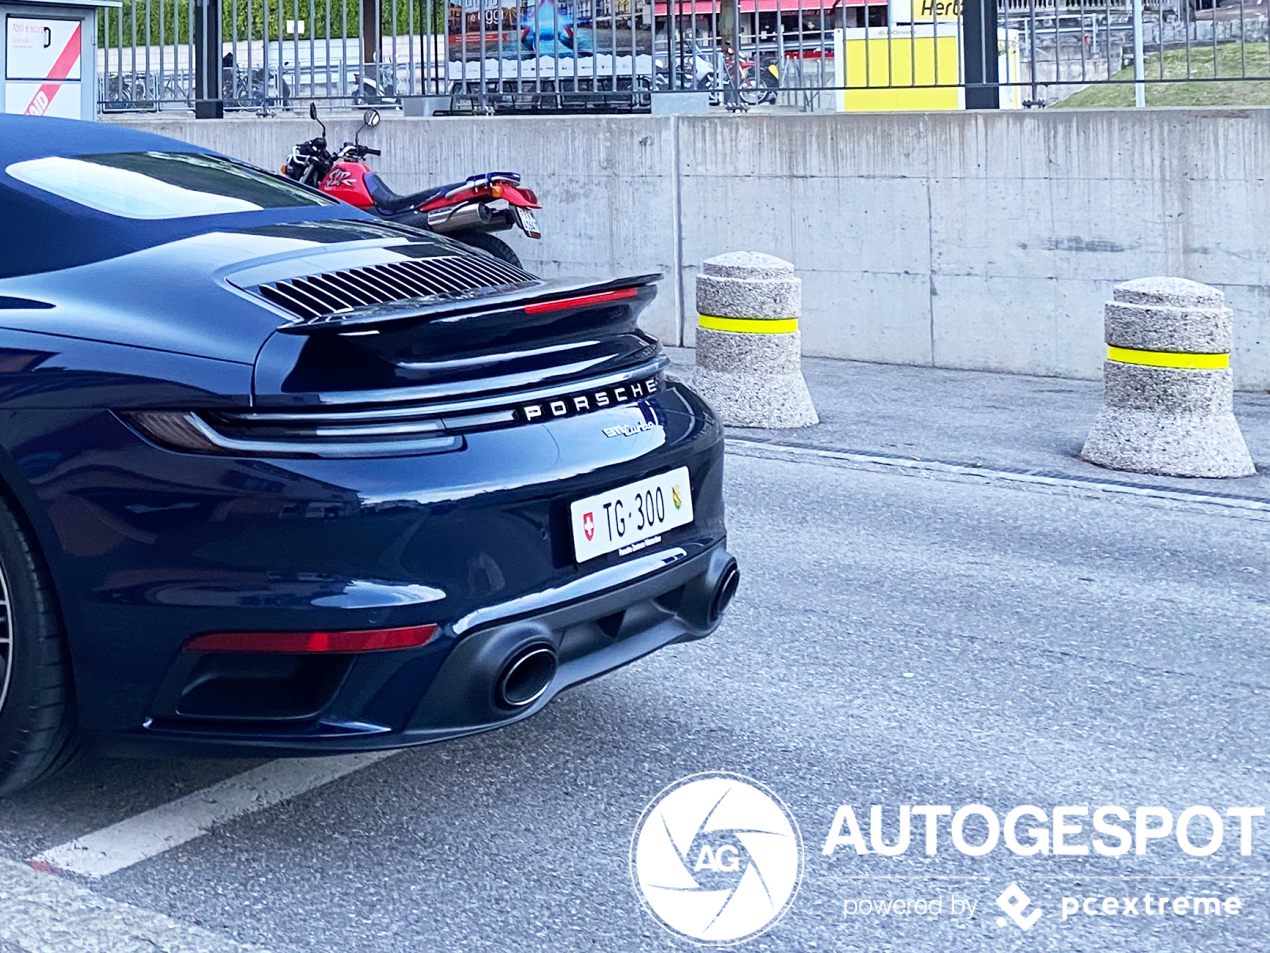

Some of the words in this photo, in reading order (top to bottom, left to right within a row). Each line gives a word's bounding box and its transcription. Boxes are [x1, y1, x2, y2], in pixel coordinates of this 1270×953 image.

[921, 0, 964, 16] Hert
[30, 26, 47, 36] scarp
[524, 379, 658, 421] PORSCHE
